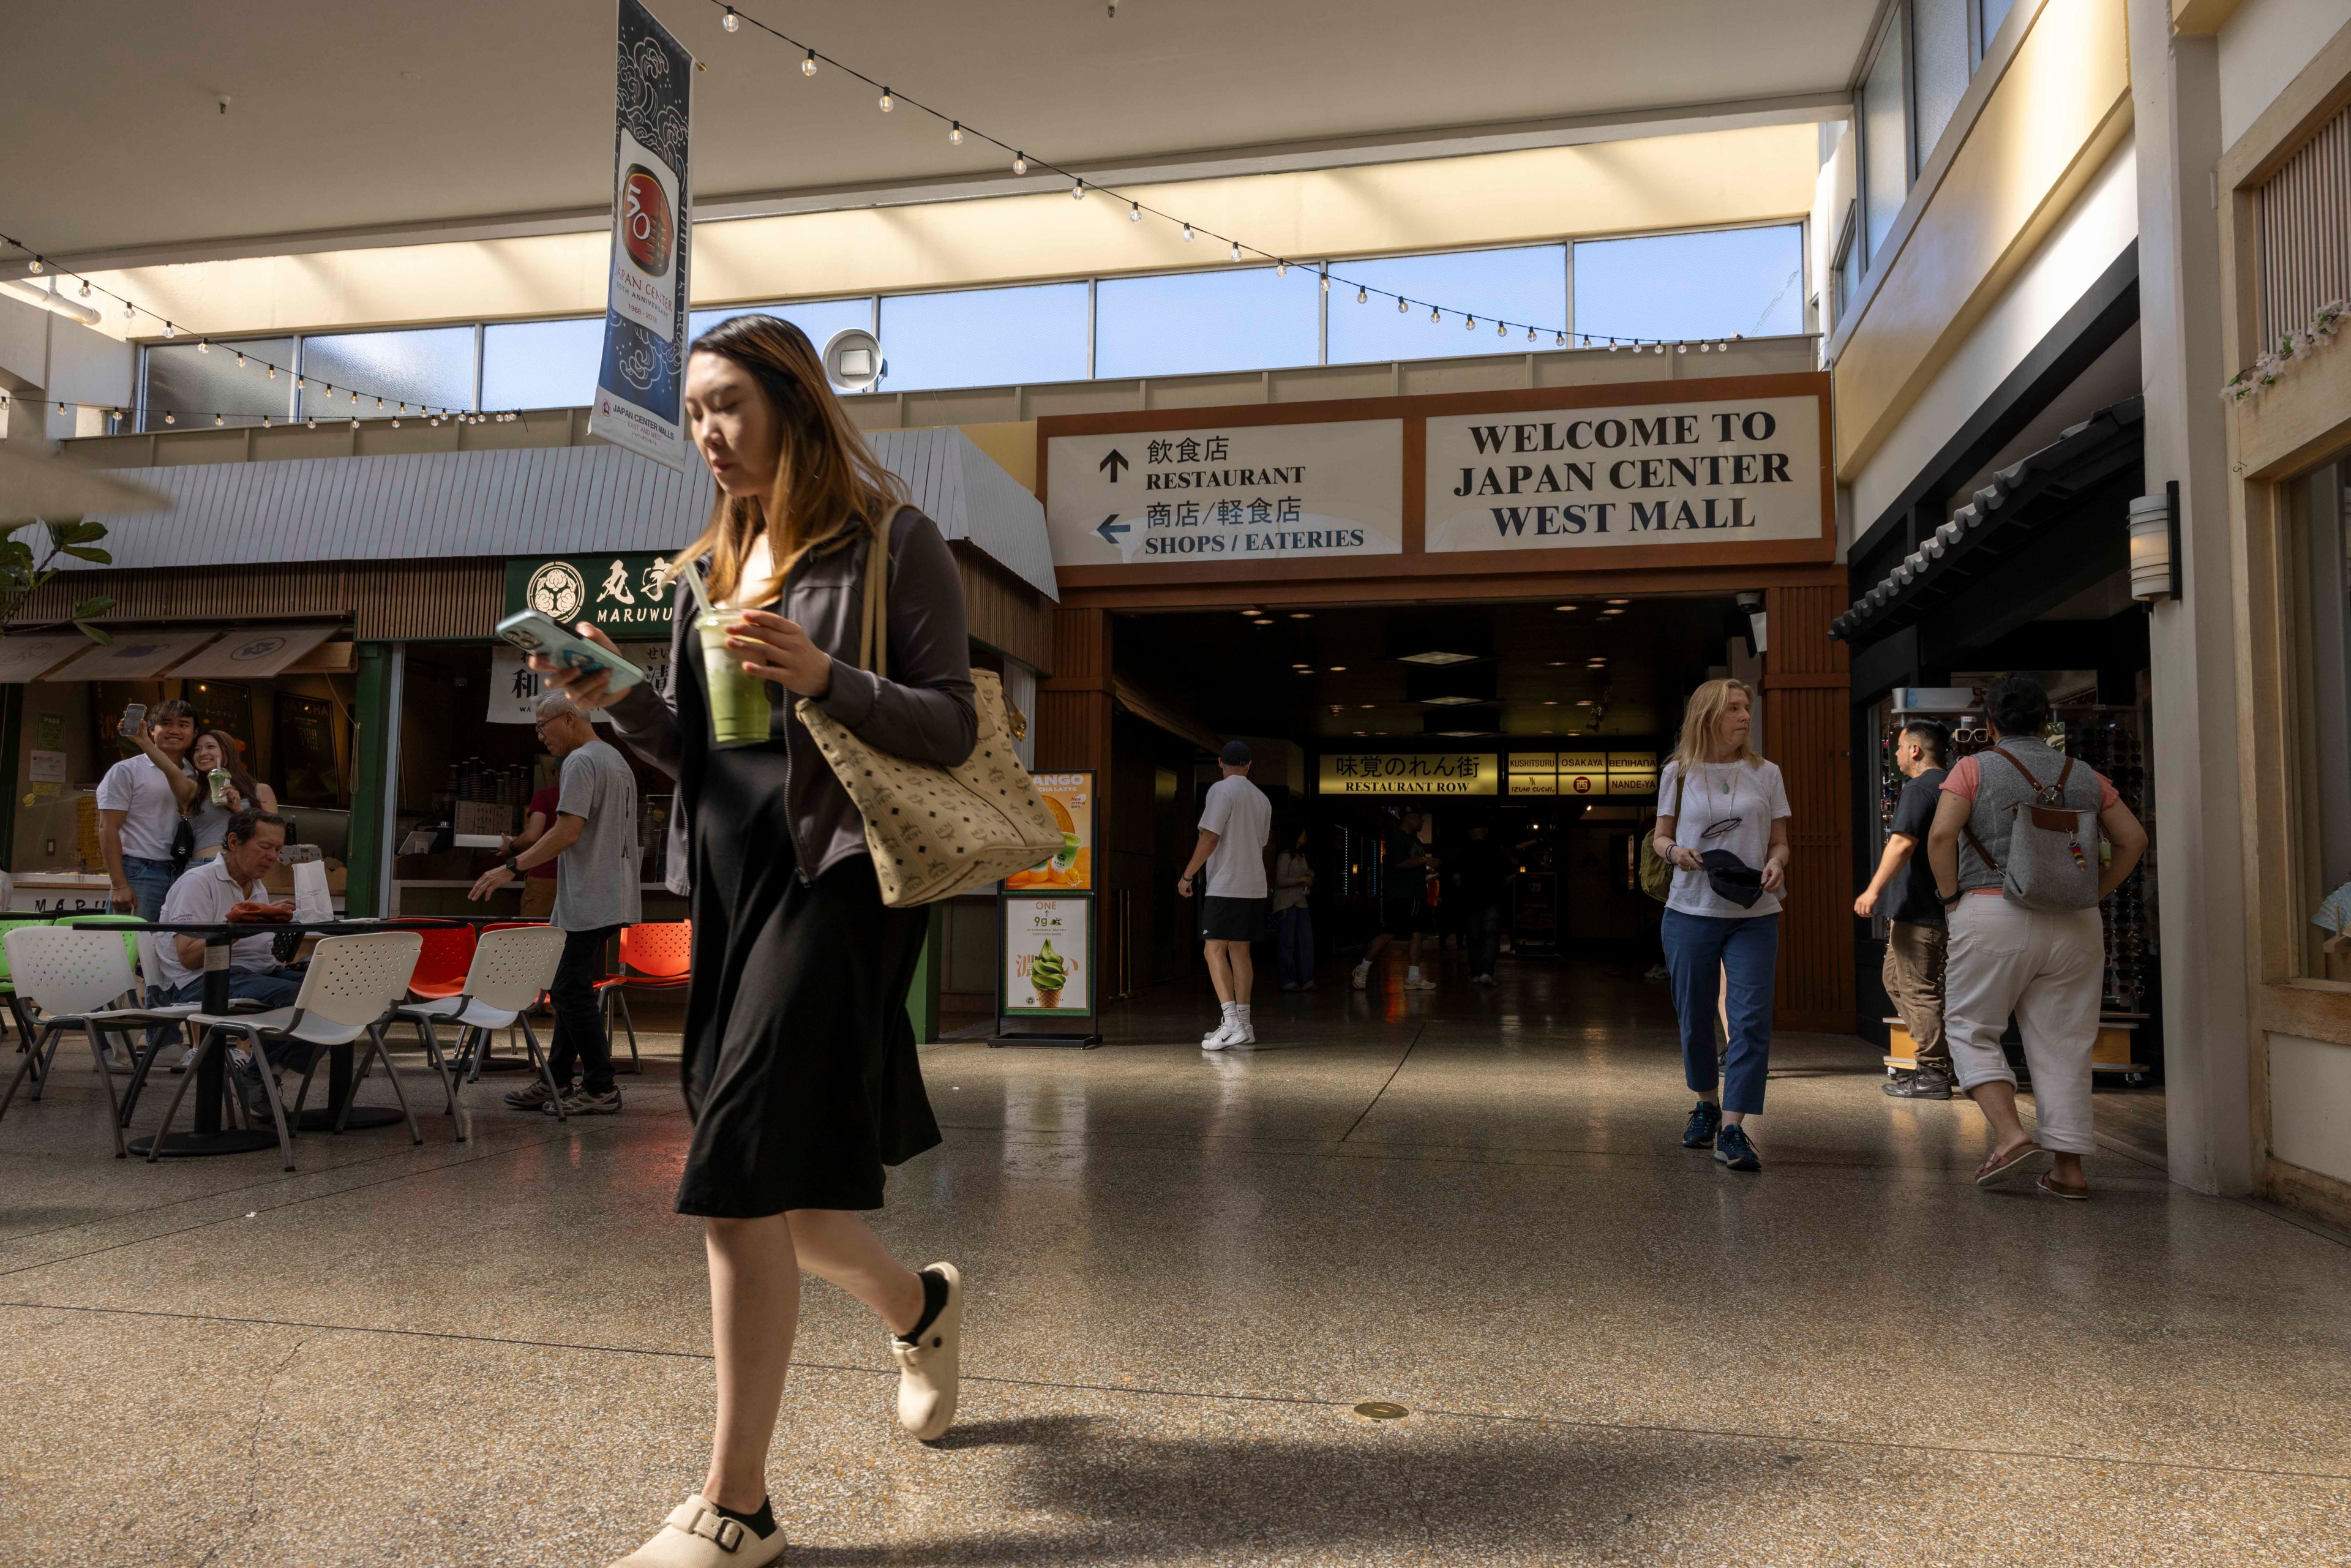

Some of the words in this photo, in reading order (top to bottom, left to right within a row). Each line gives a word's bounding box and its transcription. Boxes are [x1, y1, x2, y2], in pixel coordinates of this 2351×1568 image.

[626, 183, 651, 240] 50
[615, 262, 642, 291] JAPAN
[645, 283, 673, 313] CENTER
[616, 281, 629, 296] 50TH
[631, 292, 669, 320] ANNIVERSARY
[628, 303, 642, 316] 1968
[645, 312, 658, 324] 2018
[613, 404, 633, 421] JAPAN
[634, 414, 658, 432] CENTER
[658, 425, 674, 440] MALLS
[628, 421, 639, 431] EAST
[640, 426, 651, 436] AND
[651, 431, 662, 441] WEST
[1468, 415, 1700, 455] WELCOME
[1712, 411, 1776, 443] TO
[1147, 435, 1229, 464] 飲食店
[1146, 466, 1306, 490] RESTAURANT
[1453, 461, 1596, 497] JAPAN
[1609, 452, 1793, 490] CENTER
[1146, 495, 1302, 528] 商店/軽食店
[1490, 503, 1616, 538] WEST
[1628, 497, 1756, 532] MALL
[1145, 535, 1225, 555] SHOPS
[1245, 529, 1365, 552] EATERIES
[597, 607, 673, 623] MARUWU
[511, 668, 539, 699] 和
[1032, 774, 1084, 786] ANGO
[1335, 756, 1480, 778] 味覚のれん街
[1345, 781, 1434, 793] RESTAURANT
[1436, 781, 1470, 792] ROW
[1612, 781, 1655, 789] NANDE-YA
[1035, 901, 1057, 910] ONE
[1034, 917, 1048, 927] 9g
